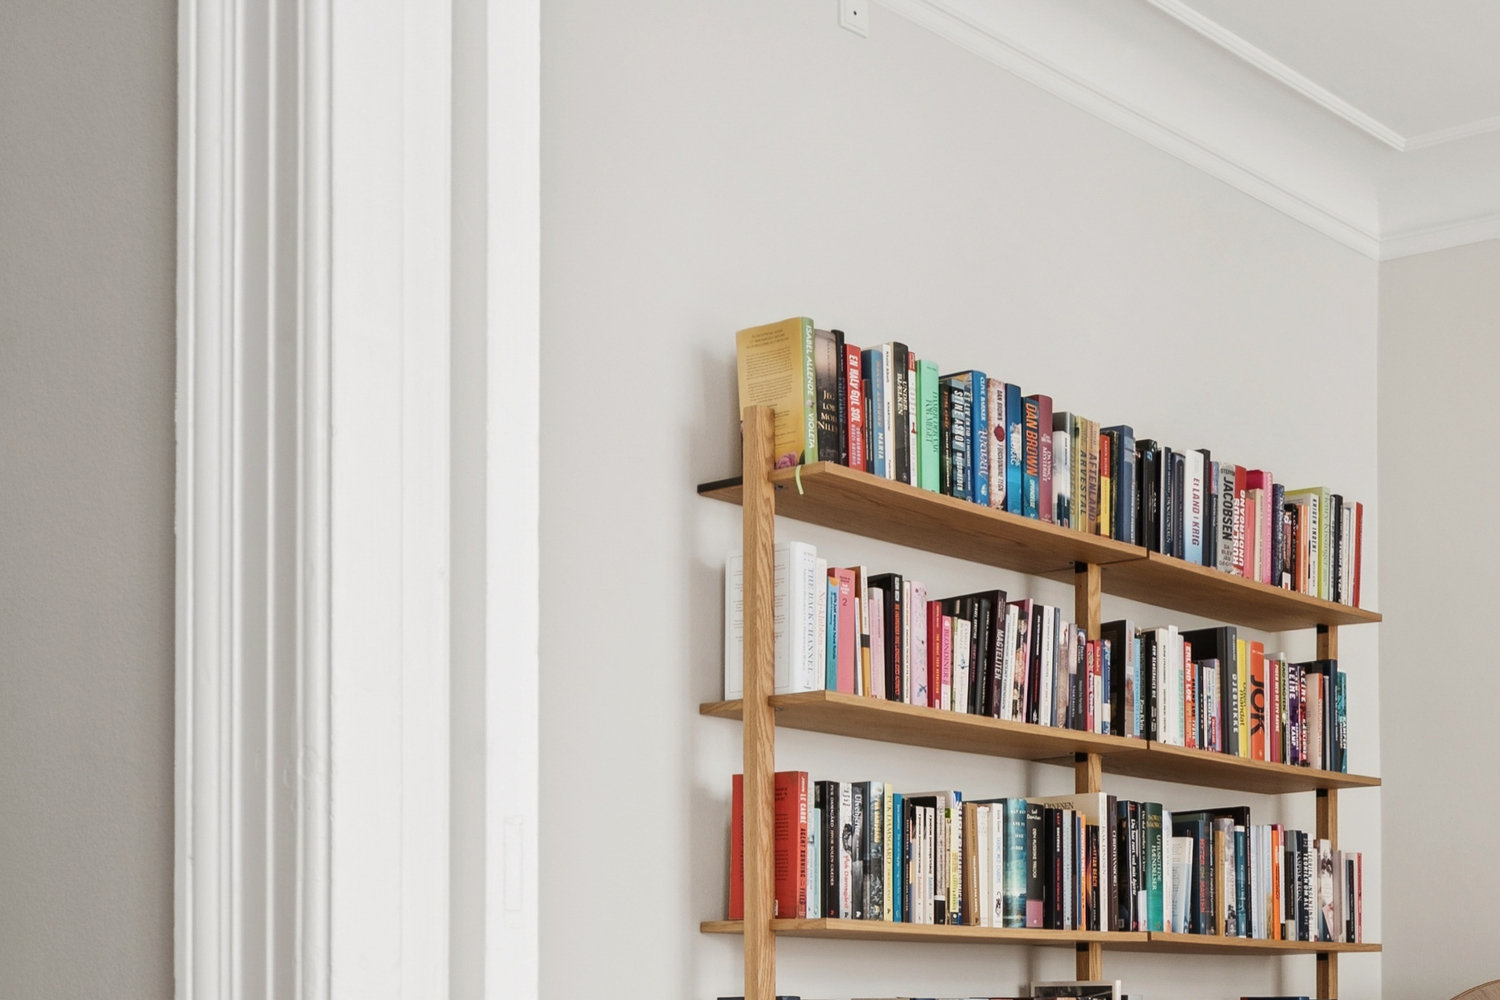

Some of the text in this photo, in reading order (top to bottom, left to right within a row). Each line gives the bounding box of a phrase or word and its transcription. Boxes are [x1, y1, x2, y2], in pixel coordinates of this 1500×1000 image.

[806, 325, 814, 396] ISABEL ALLENDE
[1026, 403, 1038, 476] DAN BROWN
[1088, 453, 1097, 522] AFTENLAND
[1222, 477, 1233, 540] JACOBSEN
[842, 598, 848, 606] 2
[995, 629, 1004, 680] MAGTELITEN
[853, 794, 861, 835] Ulvehjerter
